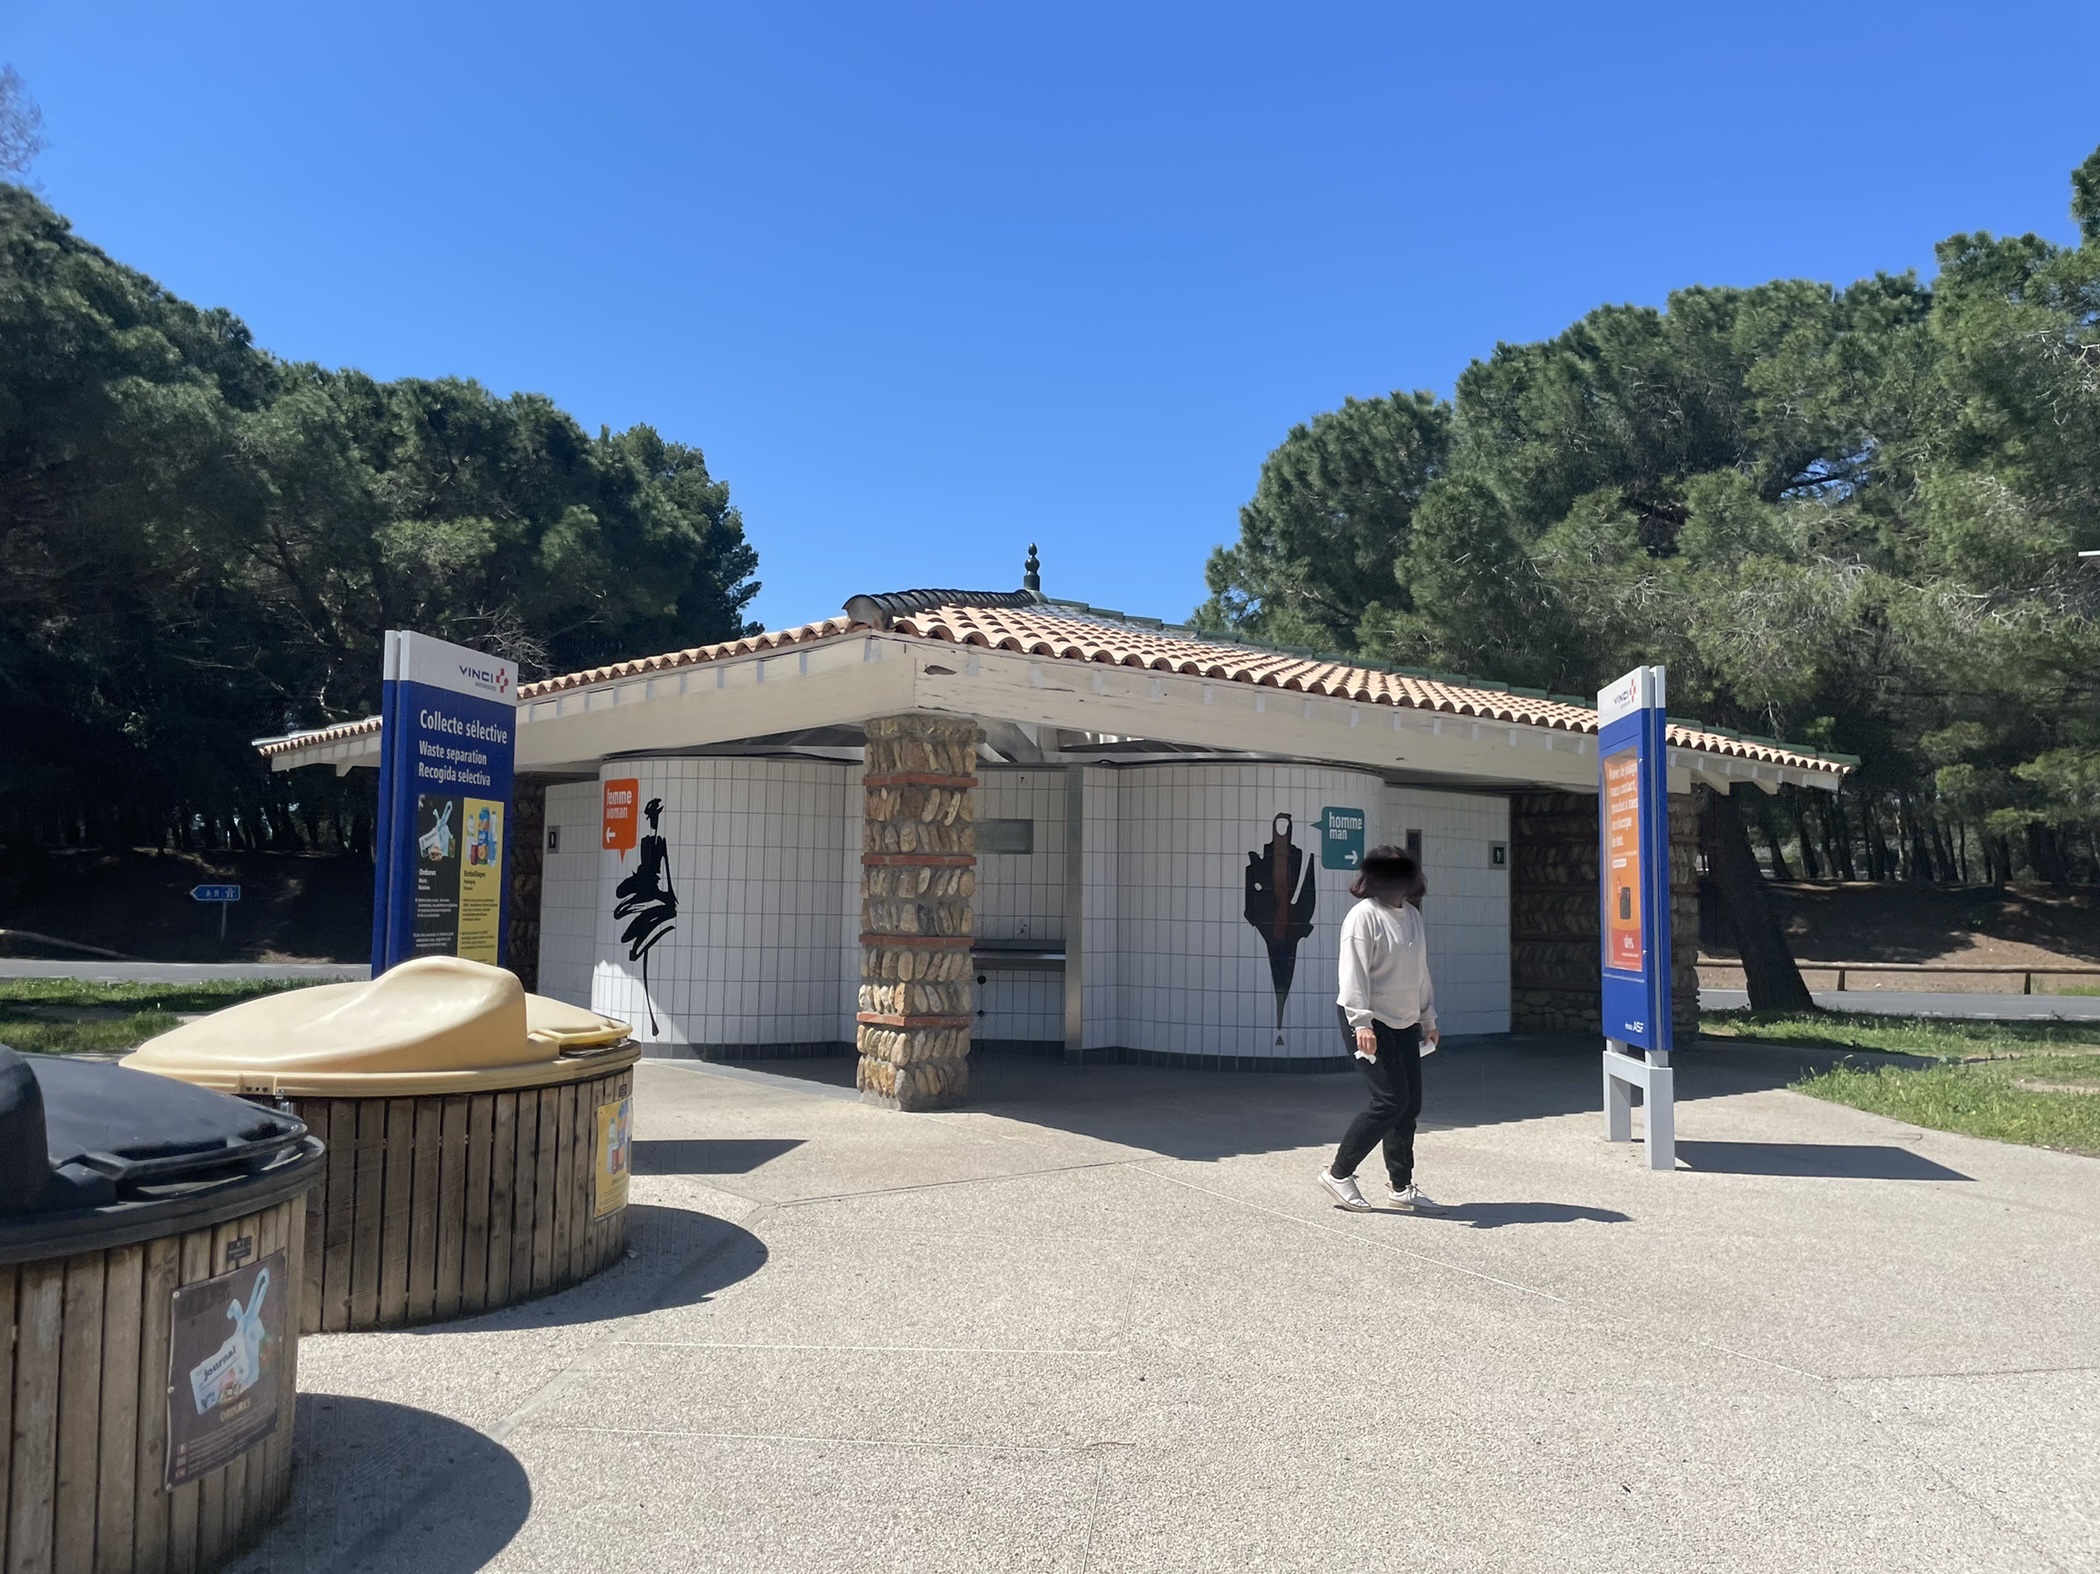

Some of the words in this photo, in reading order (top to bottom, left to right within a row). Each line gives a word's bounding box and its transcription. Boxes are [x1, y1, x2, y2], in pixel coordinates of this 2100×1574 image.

[459, 665, 493, 683] VINCI
[420, 709, 463, 735] Collecte
[466, 720, 507, 744] sélective
[419, 740, 445, 758] Waste
[446, 747, 487, 765] separation
[418, 762, 456, 784] Recogida
[458, 768, 490, 786] selectiva
[606, 788, 632, 805] femme
[606, 807, 628, 819] woman
[1329, 811, 1362, 830] homme
[1329, 829, 1347, 841] man
[206, 889, 211, 897] A
